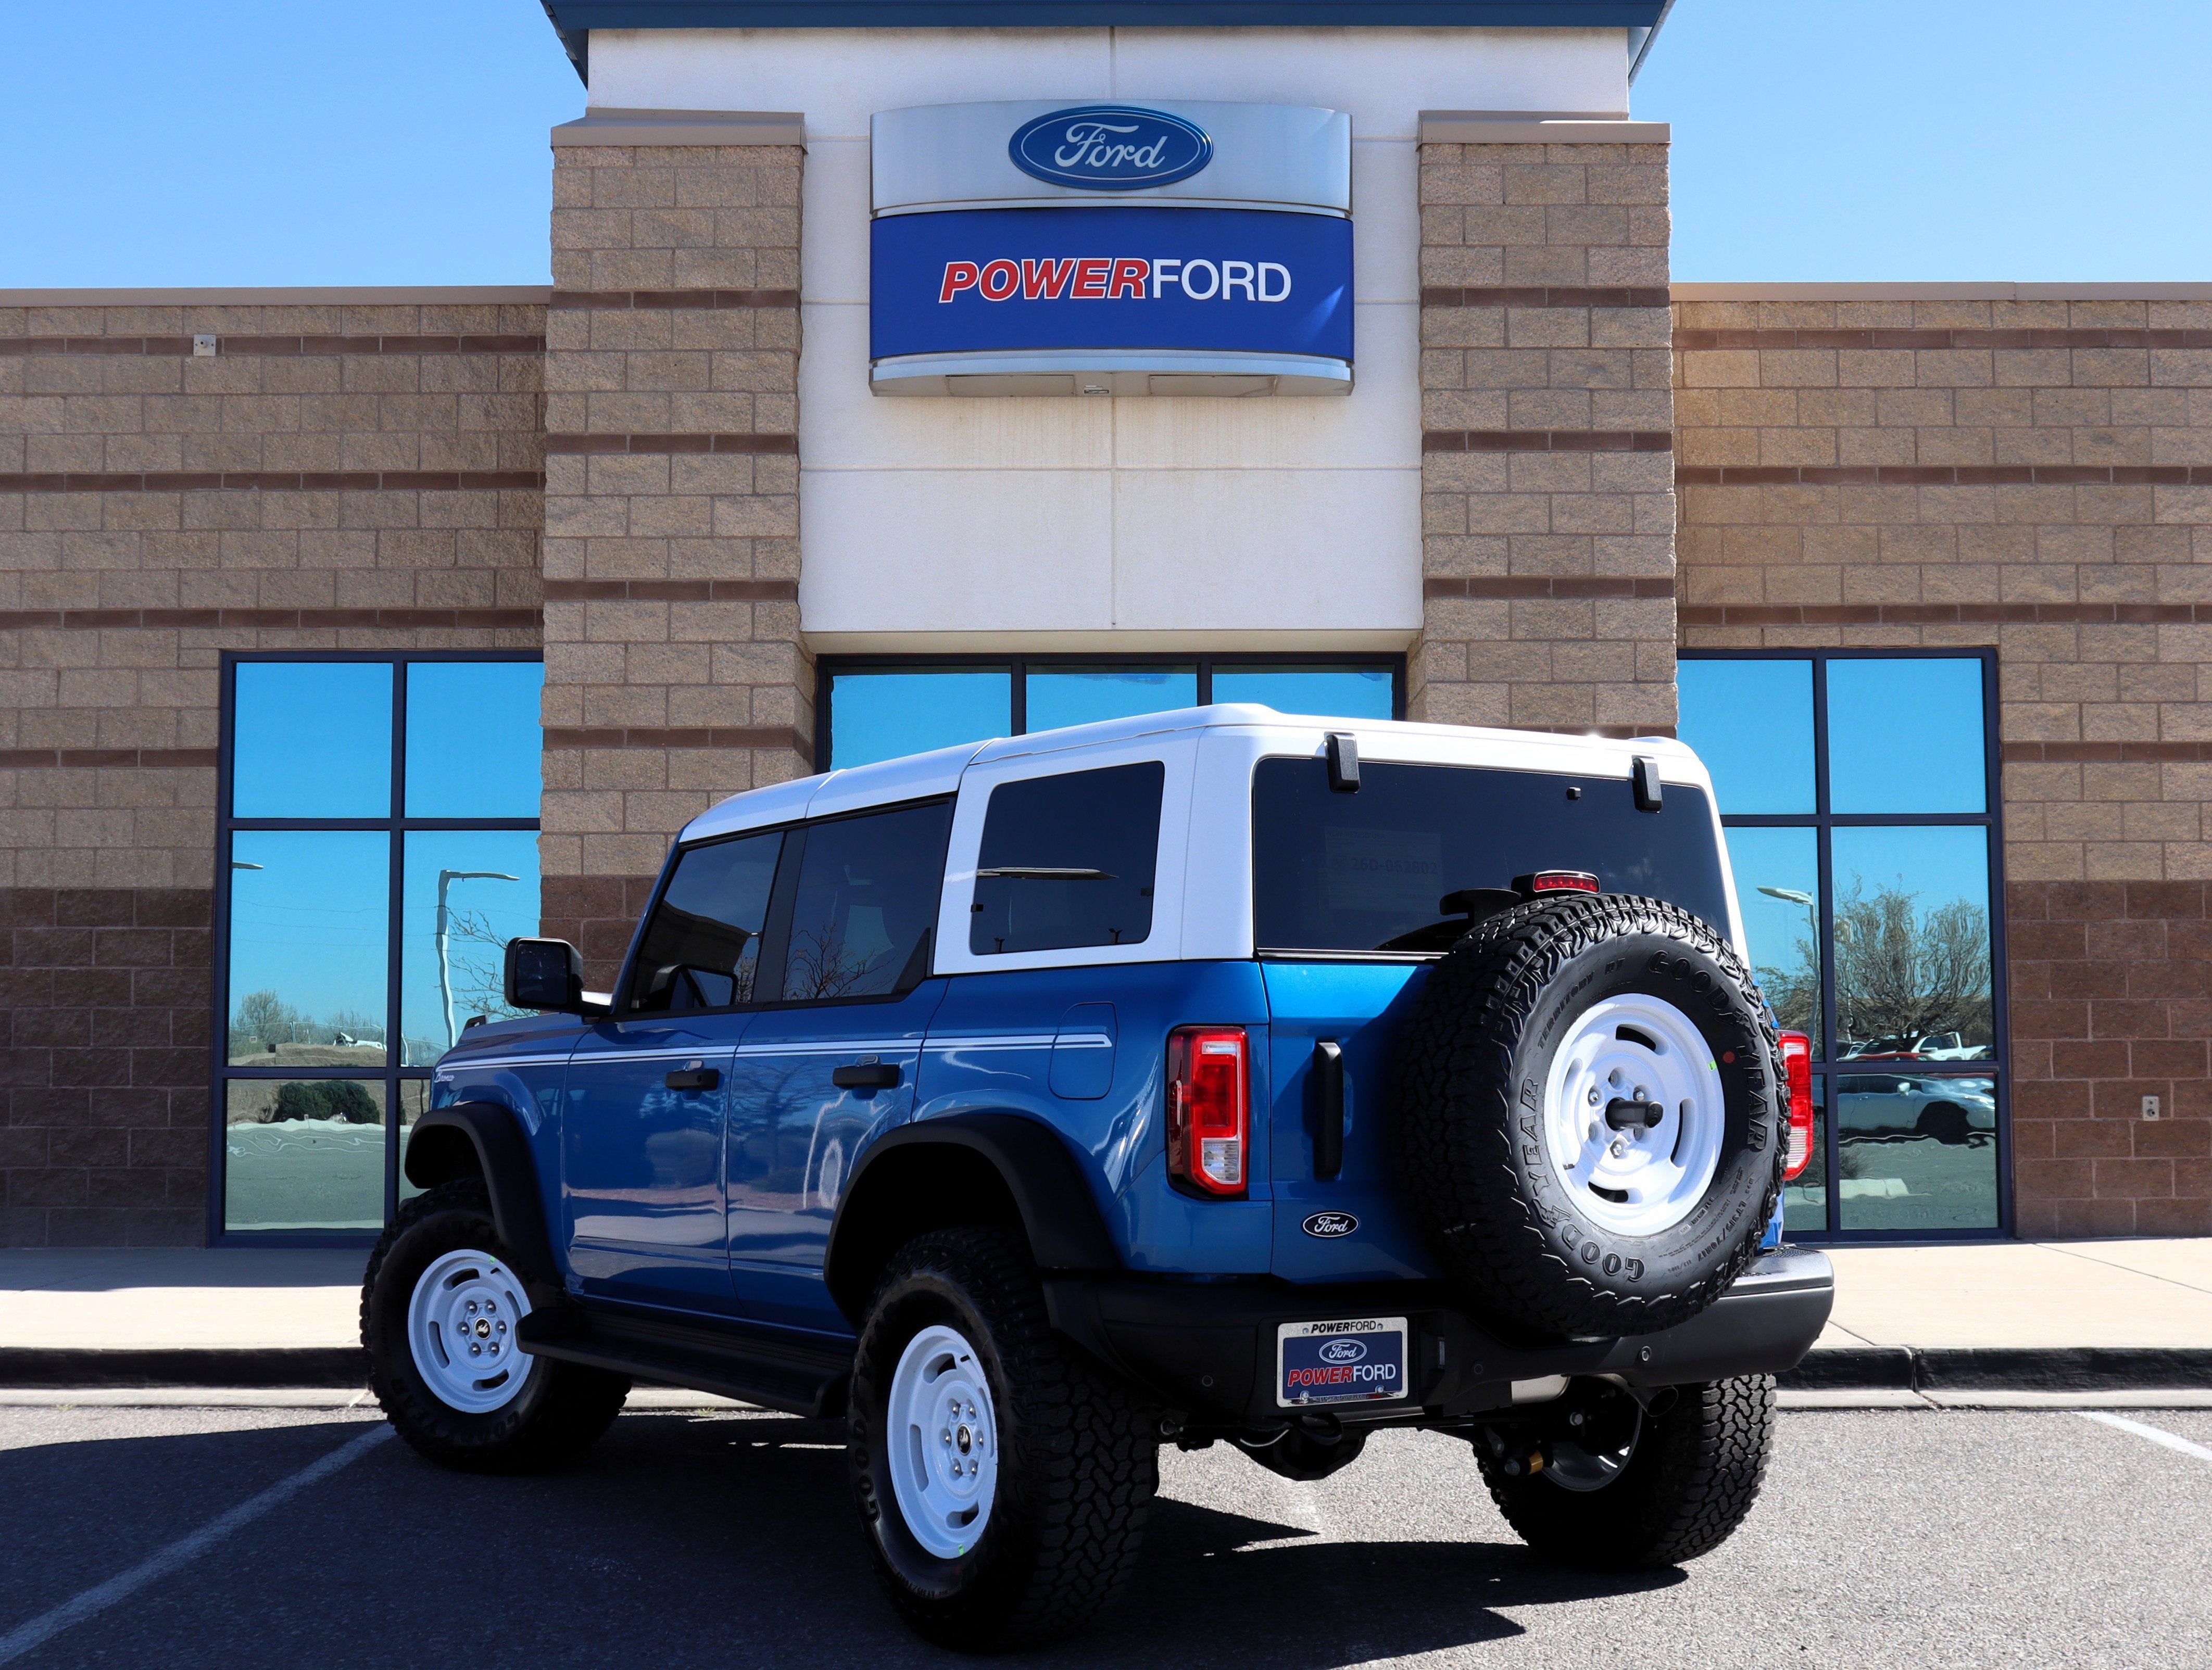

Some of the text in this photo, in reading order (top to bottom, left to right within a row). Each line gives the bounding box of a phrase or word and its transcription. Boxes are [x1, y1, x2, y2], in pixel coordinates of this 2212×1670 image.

[1054, 122, 1168, 168] Ford
[938, 257, 1291, 303] POWERFORD
[1314, 1216, 1349, 1233] Ford
[1329, 1344, 1358, 1359] Ford
